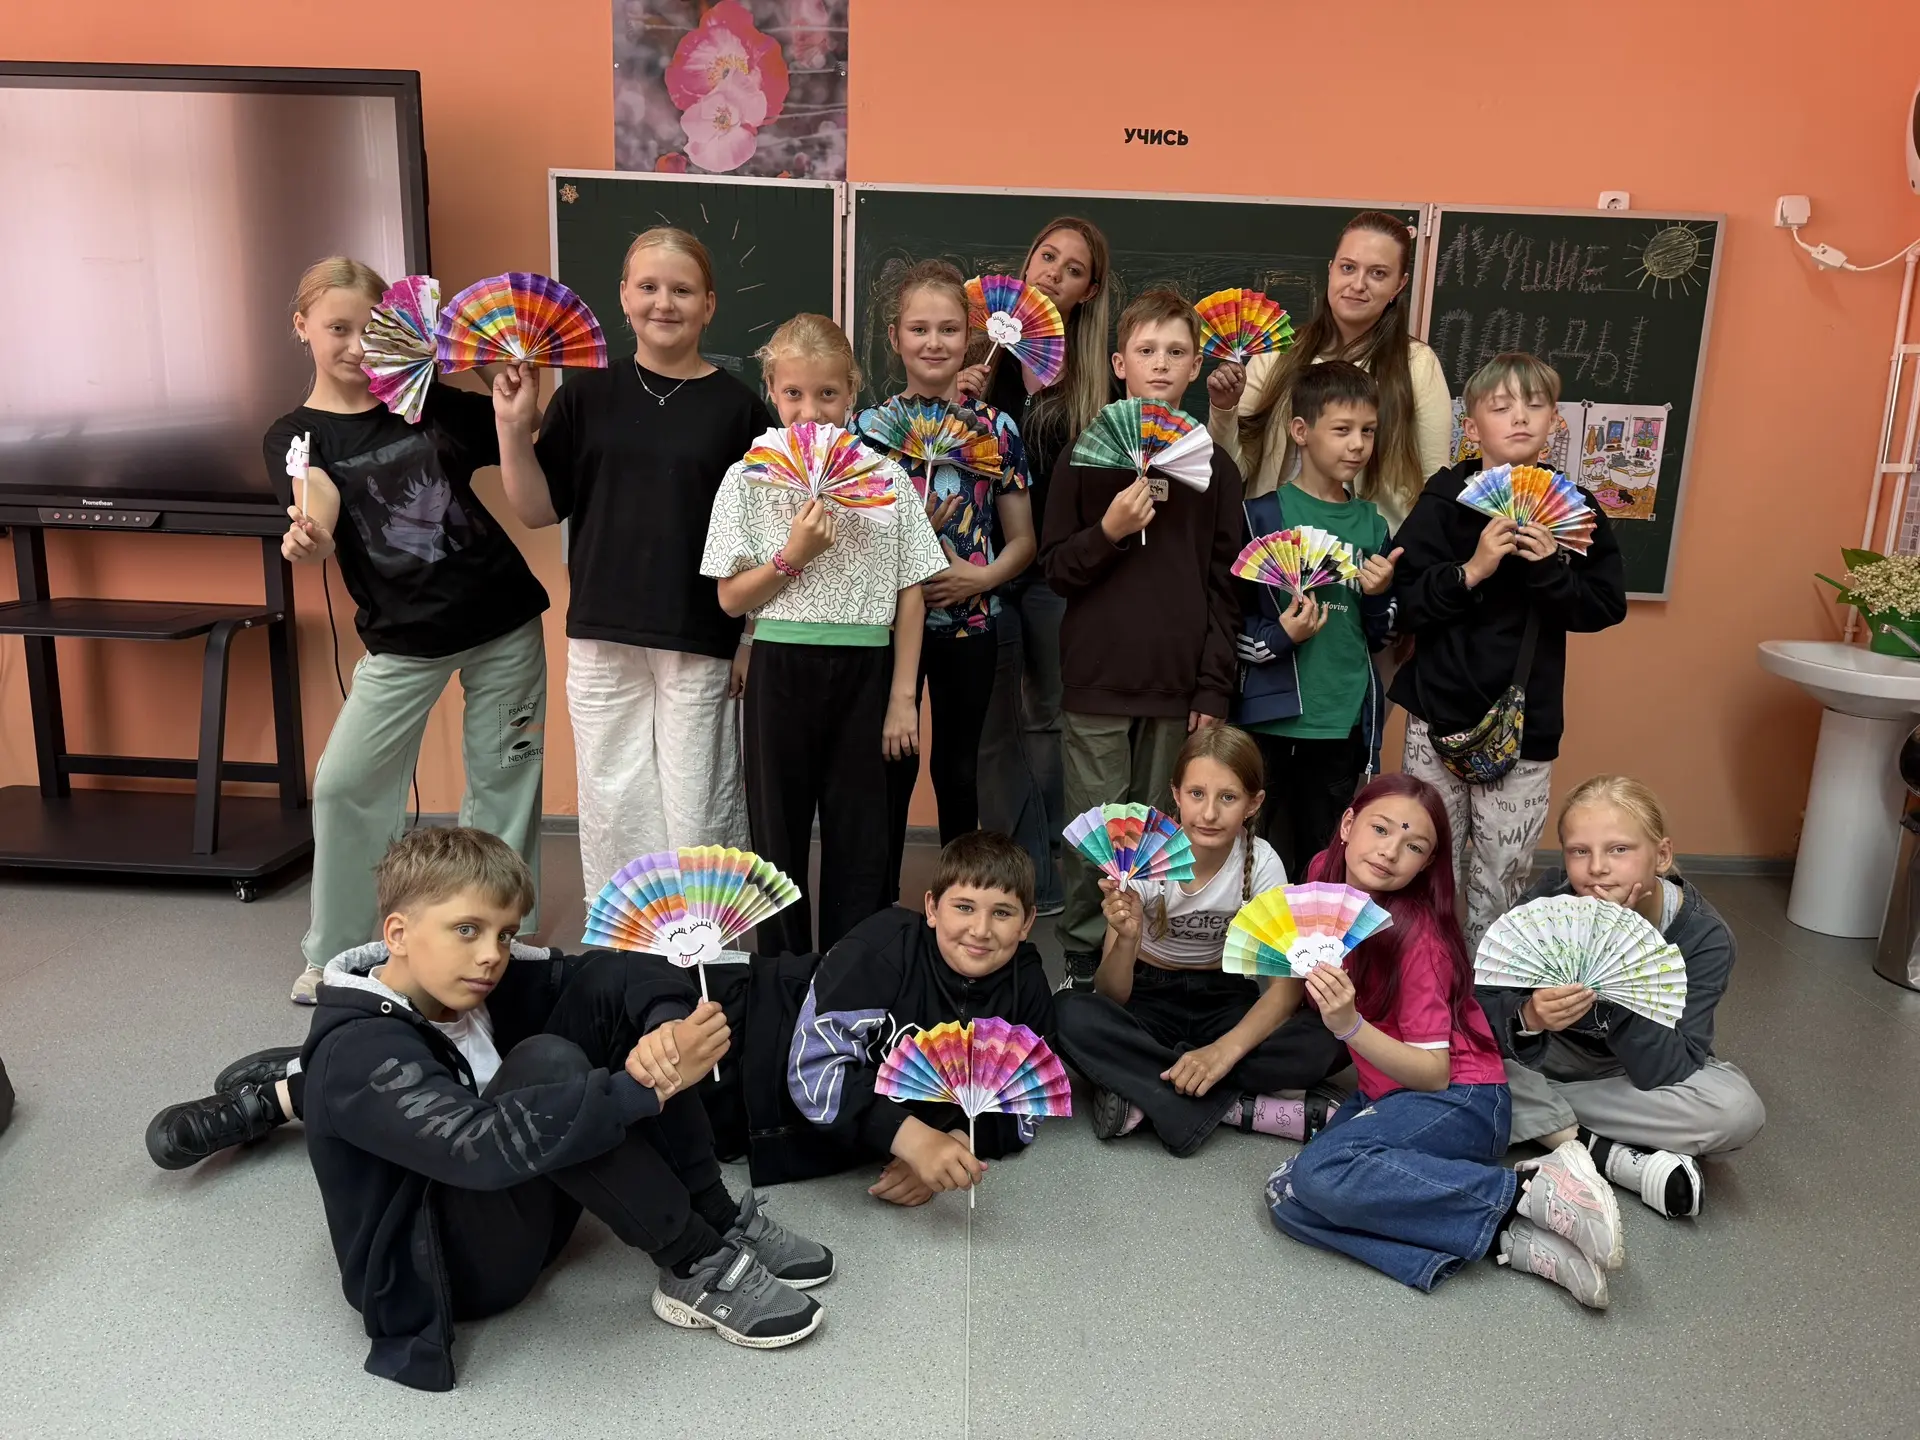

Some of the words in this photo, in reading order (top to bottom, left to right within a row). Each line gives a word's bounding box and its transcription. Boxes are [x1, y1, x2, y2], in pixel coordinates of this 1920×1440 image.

[1124, 128, 1189, 146] УЧИСЬ
[508, 702, 537, 716] FSAHIO
[1498, 818, 1535, 851] WAY
